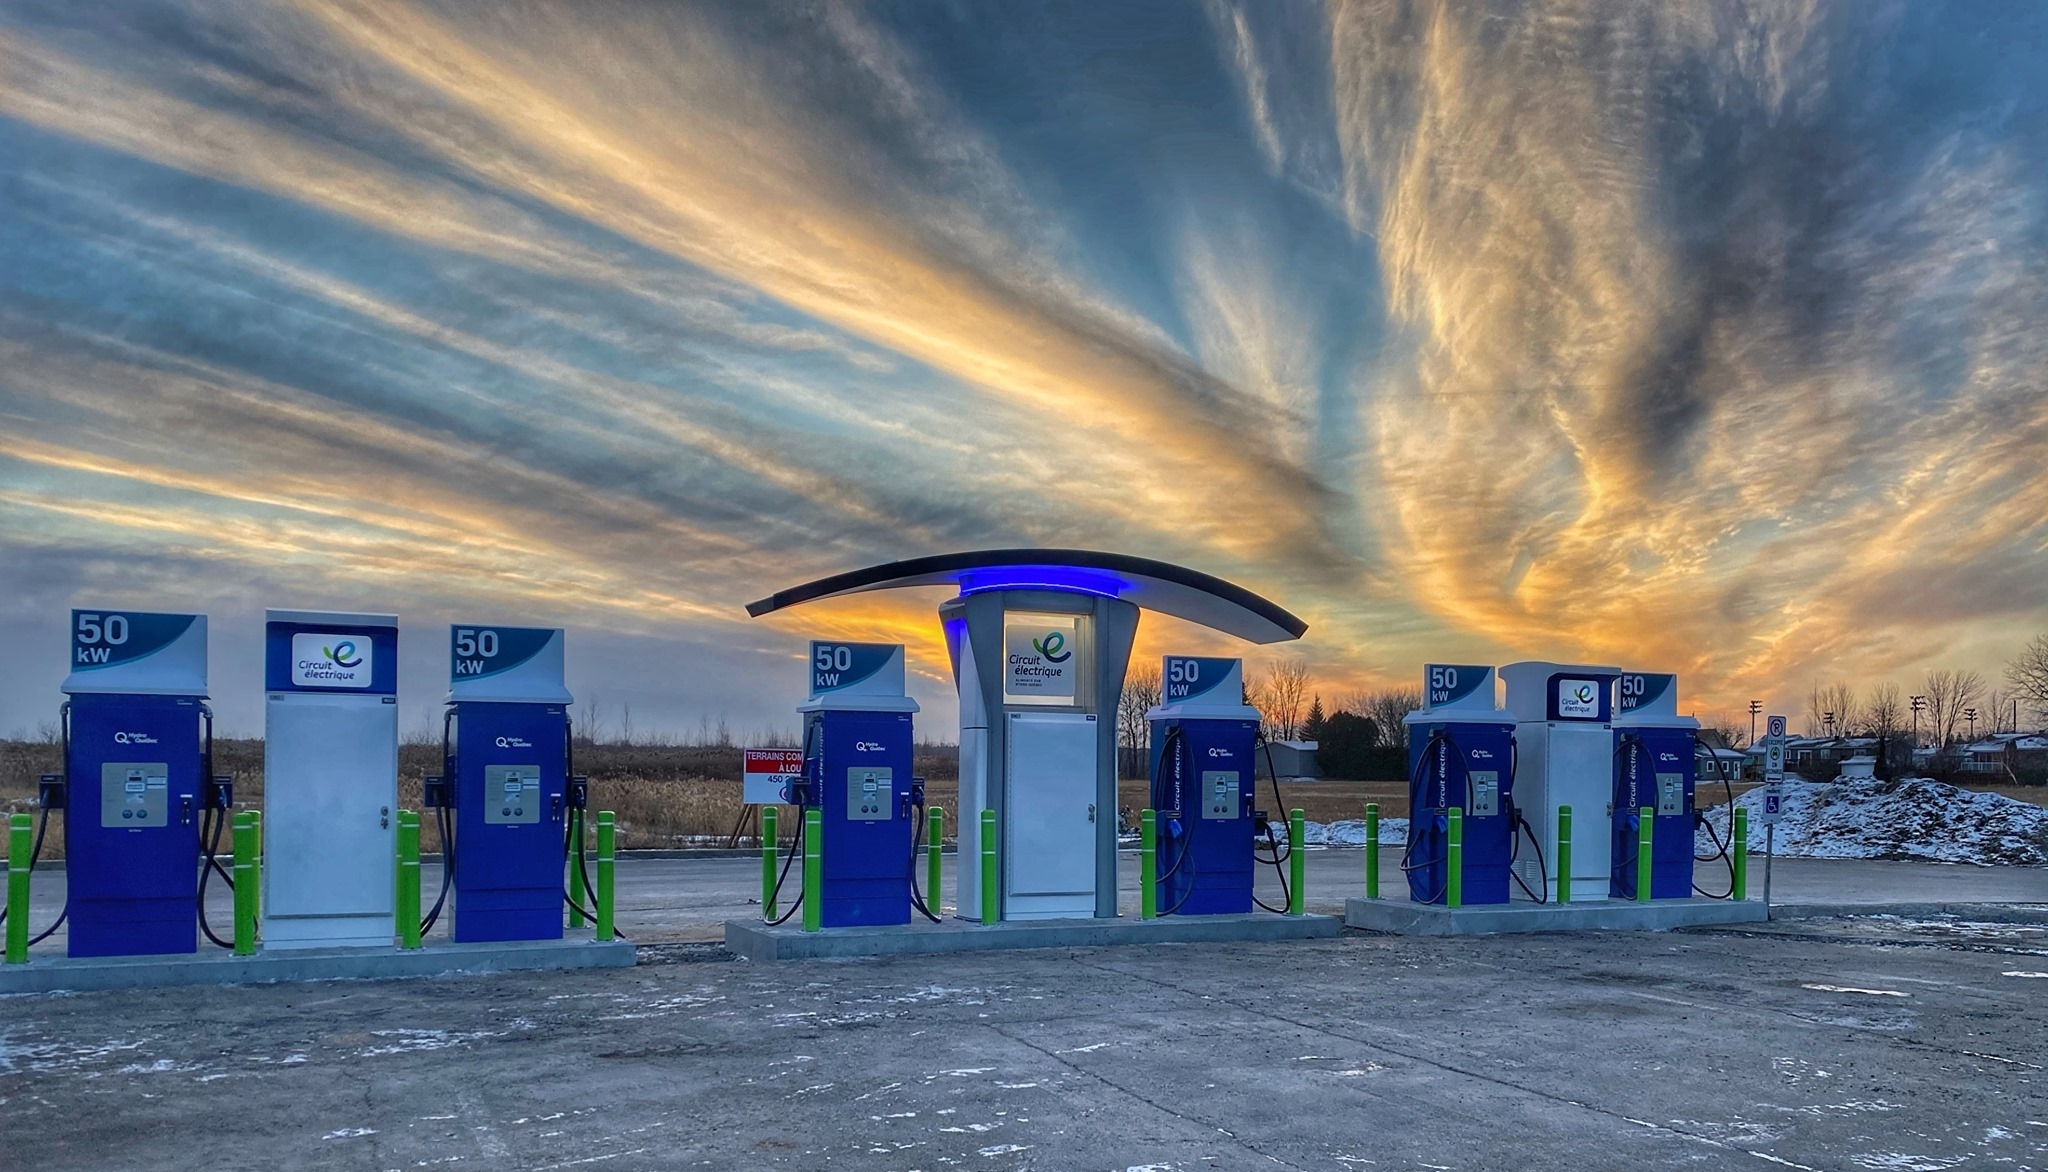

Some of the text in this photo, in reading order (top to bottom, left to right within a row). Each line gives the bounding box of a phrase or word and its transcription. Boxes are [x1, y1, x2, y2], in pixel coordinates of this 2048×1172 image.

[78, 614, 128, 644] 50
[456, 630, 498, 657] 50
[78, 648, 111, 662] kW
[816, 646, 851, 670] 50
[1009, 654, 1040, 665] Circuit
[298, 660, 332, 670] Circuit
[456, 660, 484, 674] kW
[1014, 665, 1062, 678] électrique
[1170, 660, 1199, 682] 50
[304, 670, 354, 680] électrique
[816, 673, 839, 686] kW
[1432, 668, 1457, 688] 50
[1170, 684, 1189, 696] kW
[1623, 676, 1644, 695] 50
[1432, 691, 1448, 701] kW
[1622, 697, 1637, 707] kW
[1565, 705, 1590, 713] électrique
[746, 752, 784, 760] TERRAINS
[779, 762, 785, 772] À
